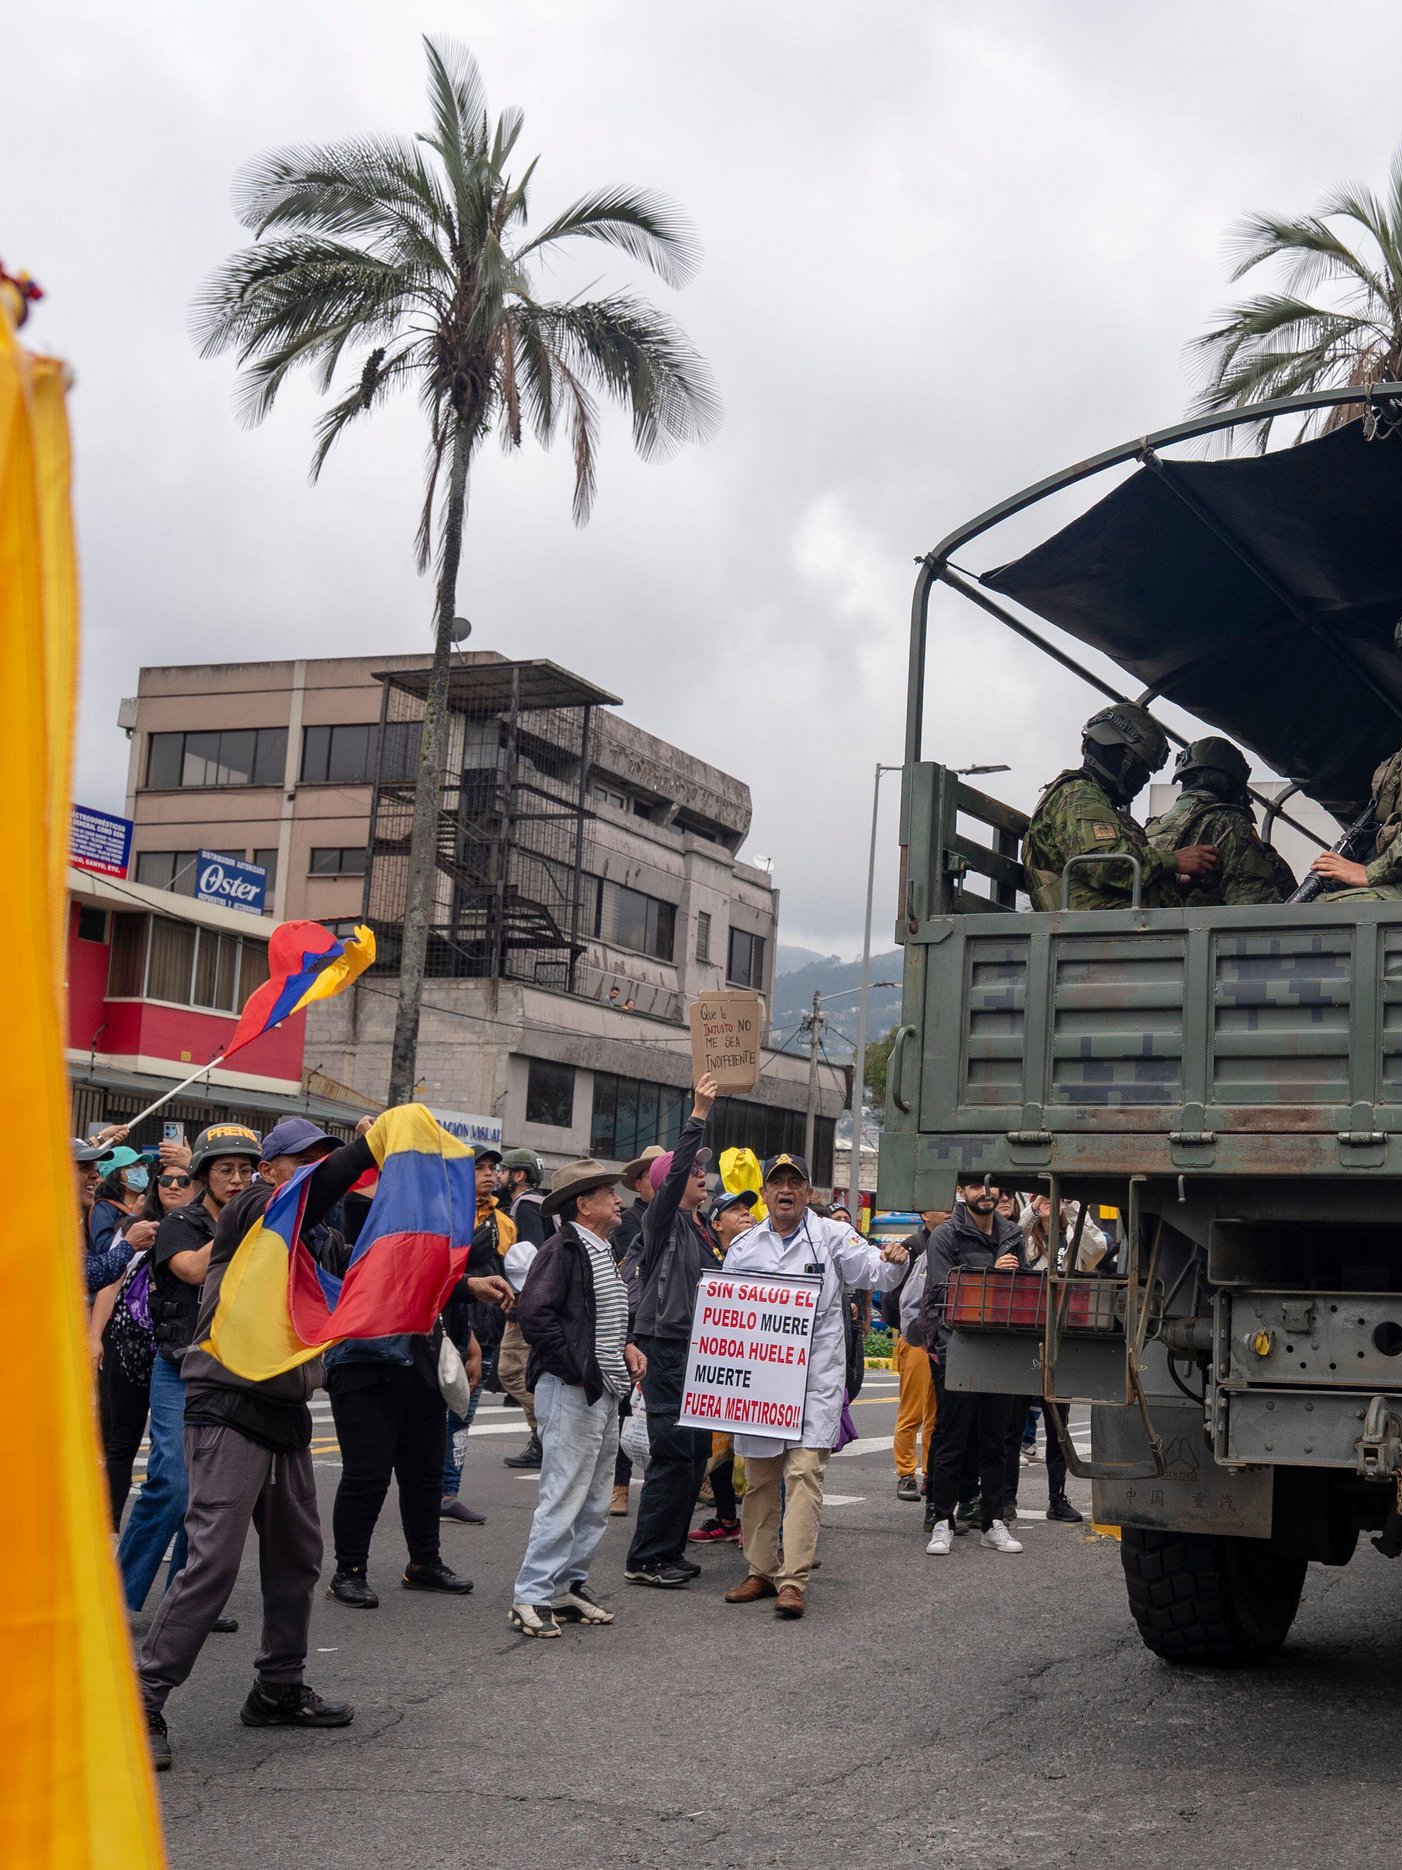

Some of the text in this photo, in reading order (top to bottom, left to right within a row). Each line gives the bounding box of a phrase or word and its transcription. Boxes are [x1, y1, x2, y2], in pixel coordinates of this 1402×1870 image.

[97, 825, 113, 835] COMO
[202, 850, 266, 875] DISTRIBUIDOR AUTORIZADO
[200, 864, 261, 901] Oster
[701, 1003, 716, 1021] Que
[703, 1019, 752, 1036] INJUSTO NO
[706, 1036, 740, 1049] ME SEA
[738, 1284, 791, 1305] SALUD
[794, 1290, 814, 1308] EL
[703, 1307, 810, 1336] PUEBLO MUERE
[748, 1342, 795, 1365] HUELE
[797, 1347, 806, 1366] A
[694, 1364, 752, 1388] MUERTE
[683, 1392, 801, 1428] FUERA MENTIROSO!!
